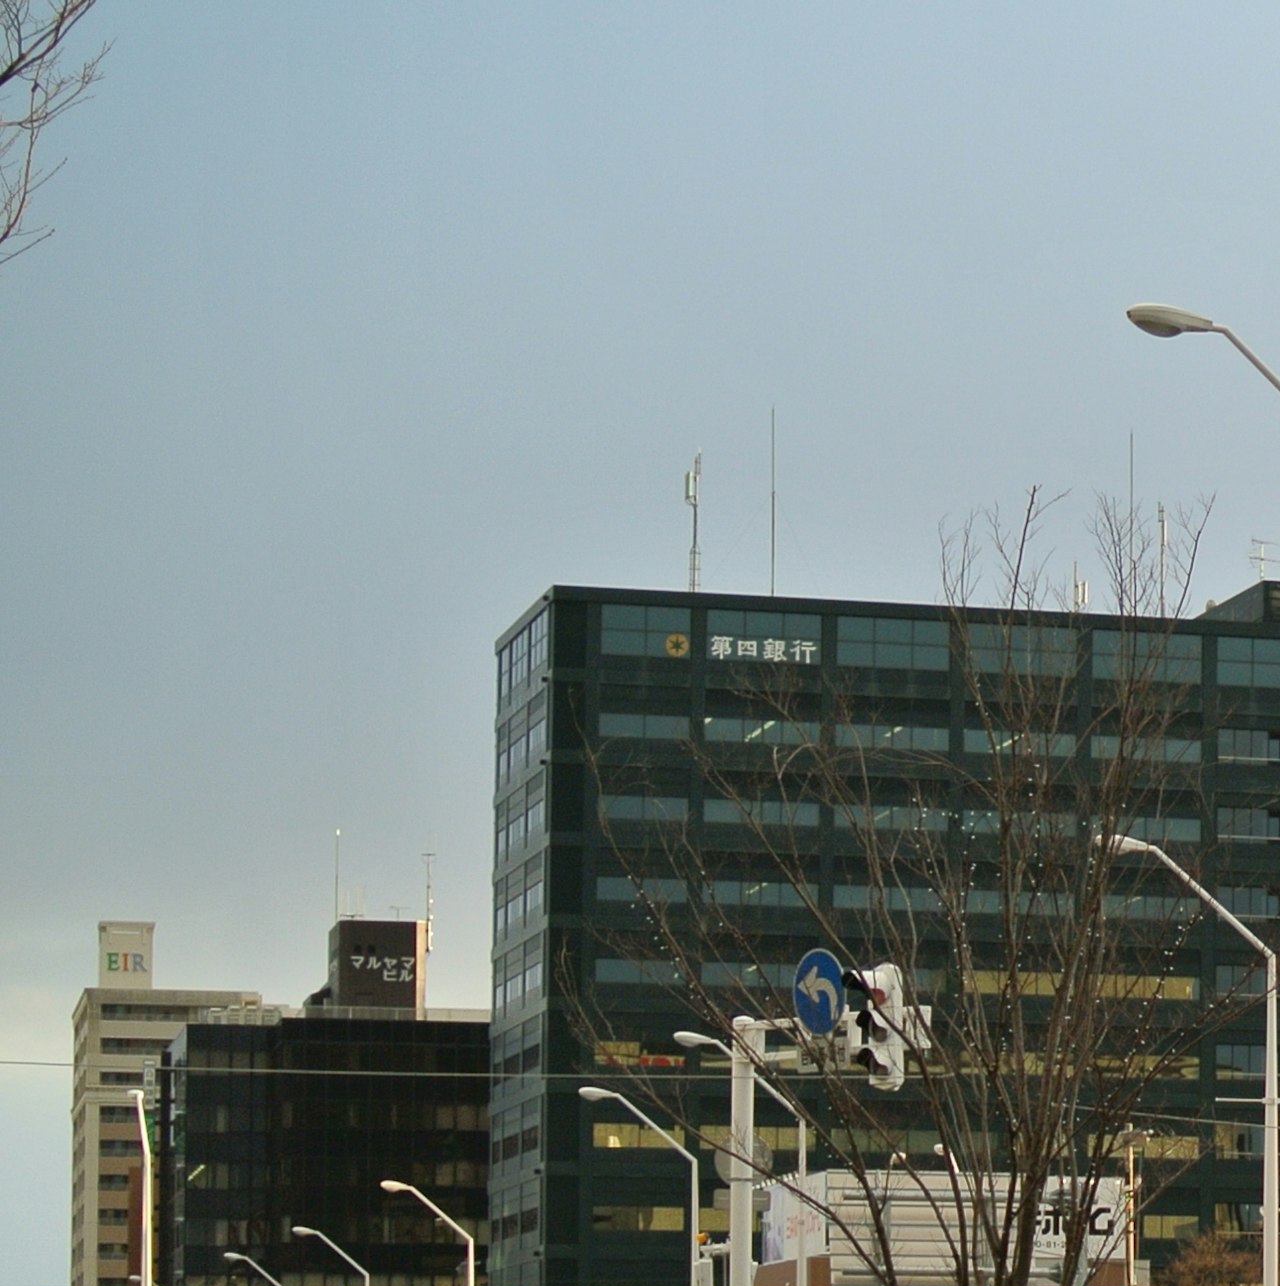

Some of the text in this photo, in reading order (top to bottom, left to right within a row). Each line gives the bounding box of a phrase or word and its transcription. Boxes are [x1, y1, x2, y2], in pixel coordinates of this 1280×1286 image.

[711, 635, 817, 664] 第四銀行
[106, 952, 148, 972] EIR
[350, 955, 414, 970] マルヤマ
[382, 969, 413, 983] ビル
